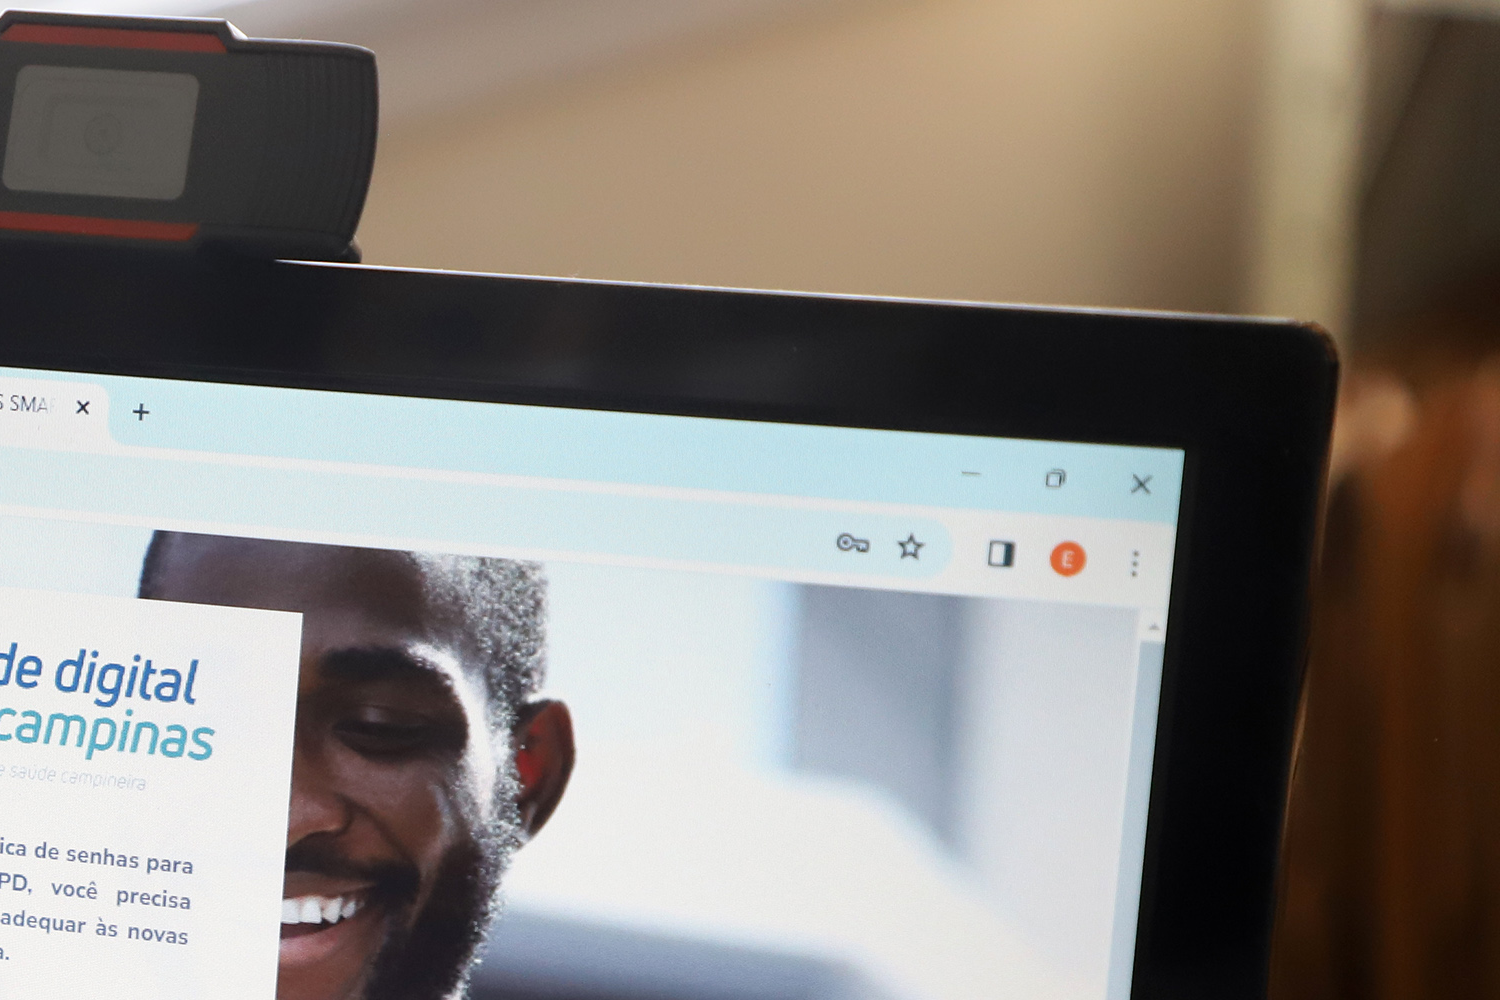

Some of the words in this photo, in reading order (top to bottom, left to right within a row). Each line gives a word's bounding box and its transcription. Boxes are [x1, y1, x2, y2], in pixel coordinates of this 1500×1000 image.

[54, 648, 199, 708] digital
[8, 764, 57, 782] saúde
[60, 770, 147, 792] campineira
[34, 841, 60, 860] de
[66, 848, 140, 869] senhas
[146, 856, 194, 875] para
[51, 881, 98, 900] você
[116, 889, 192, 910] precisa
[0, 910, 87, 934] adequar
[95, 917, 118, 938] às
[127, 925, 189, 946] novas
